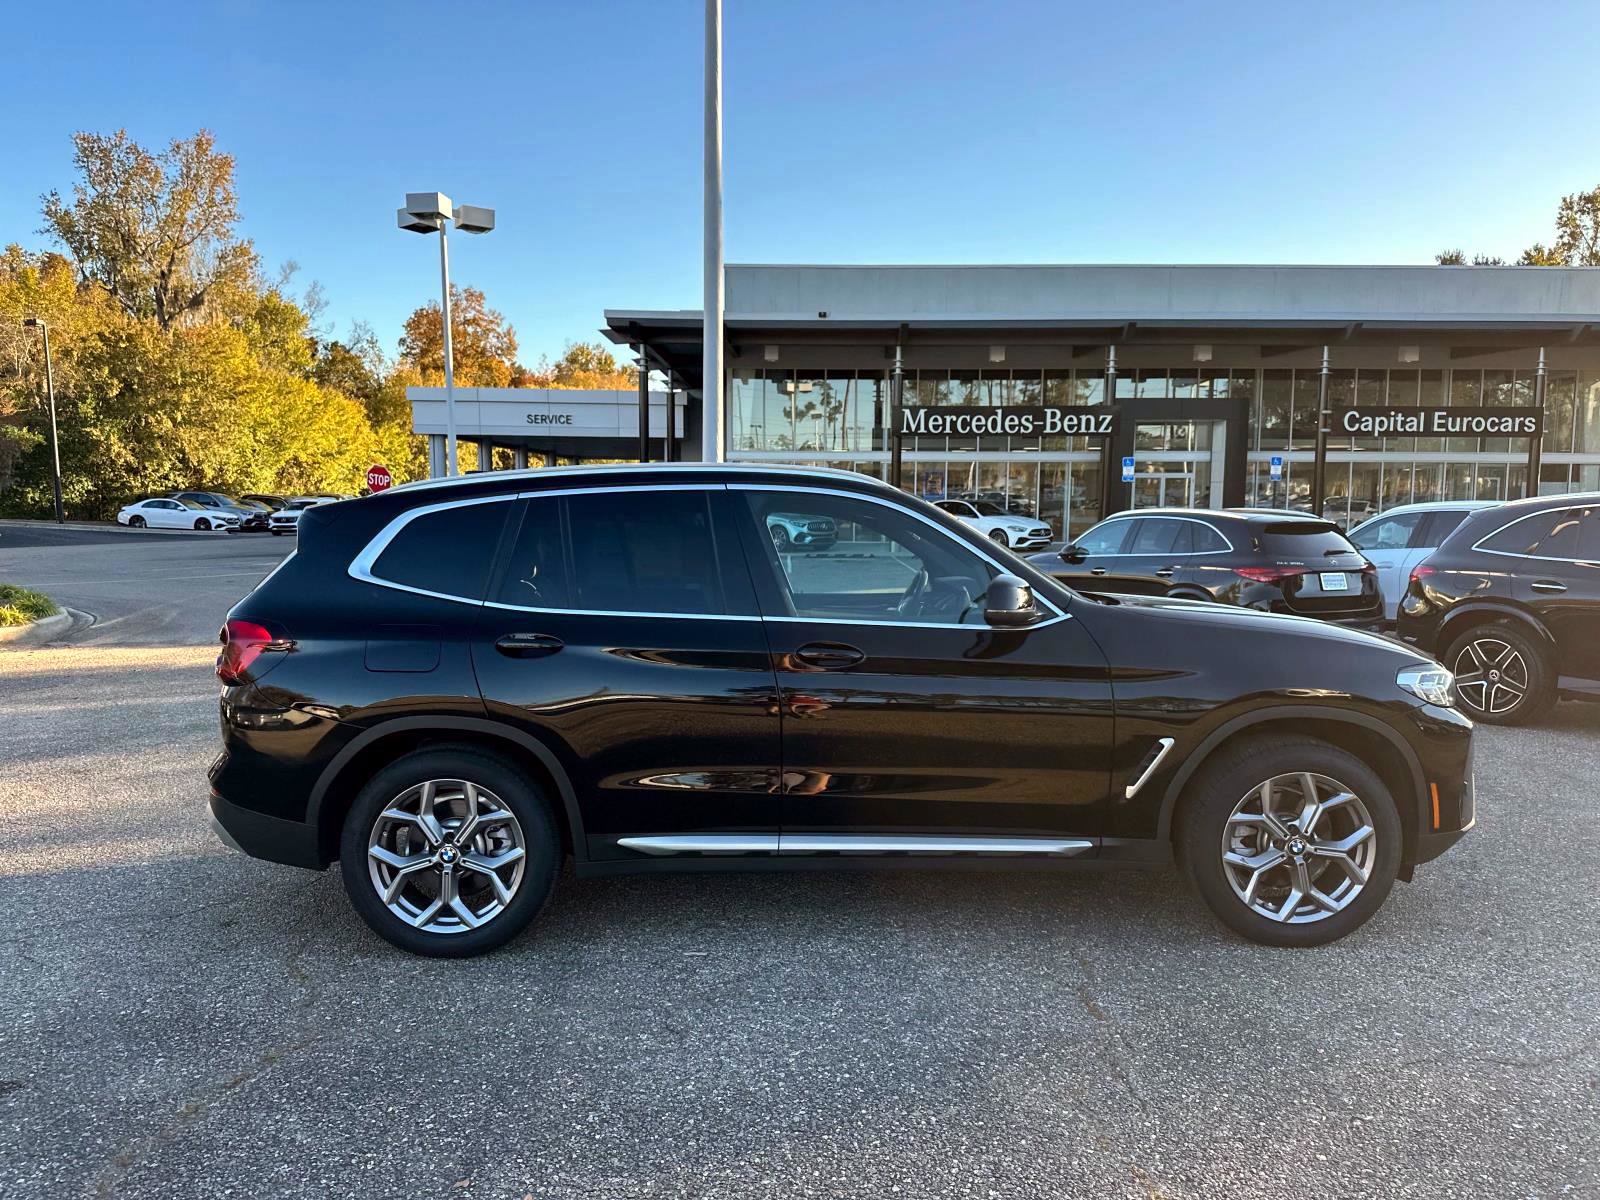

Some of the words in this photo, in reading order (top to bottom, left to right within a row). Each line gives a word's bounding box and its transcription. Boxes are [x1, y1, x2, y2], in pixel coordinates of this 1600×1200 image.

[526, 413, 573, 425] SERVICE
[901, 408, 1113, 433] Mercedes-Benz
[1343, 410, 1425, 437] Capital
[1433, 411, 1536, 433] Eurocars
[368, 473, 390, 487] STOP
